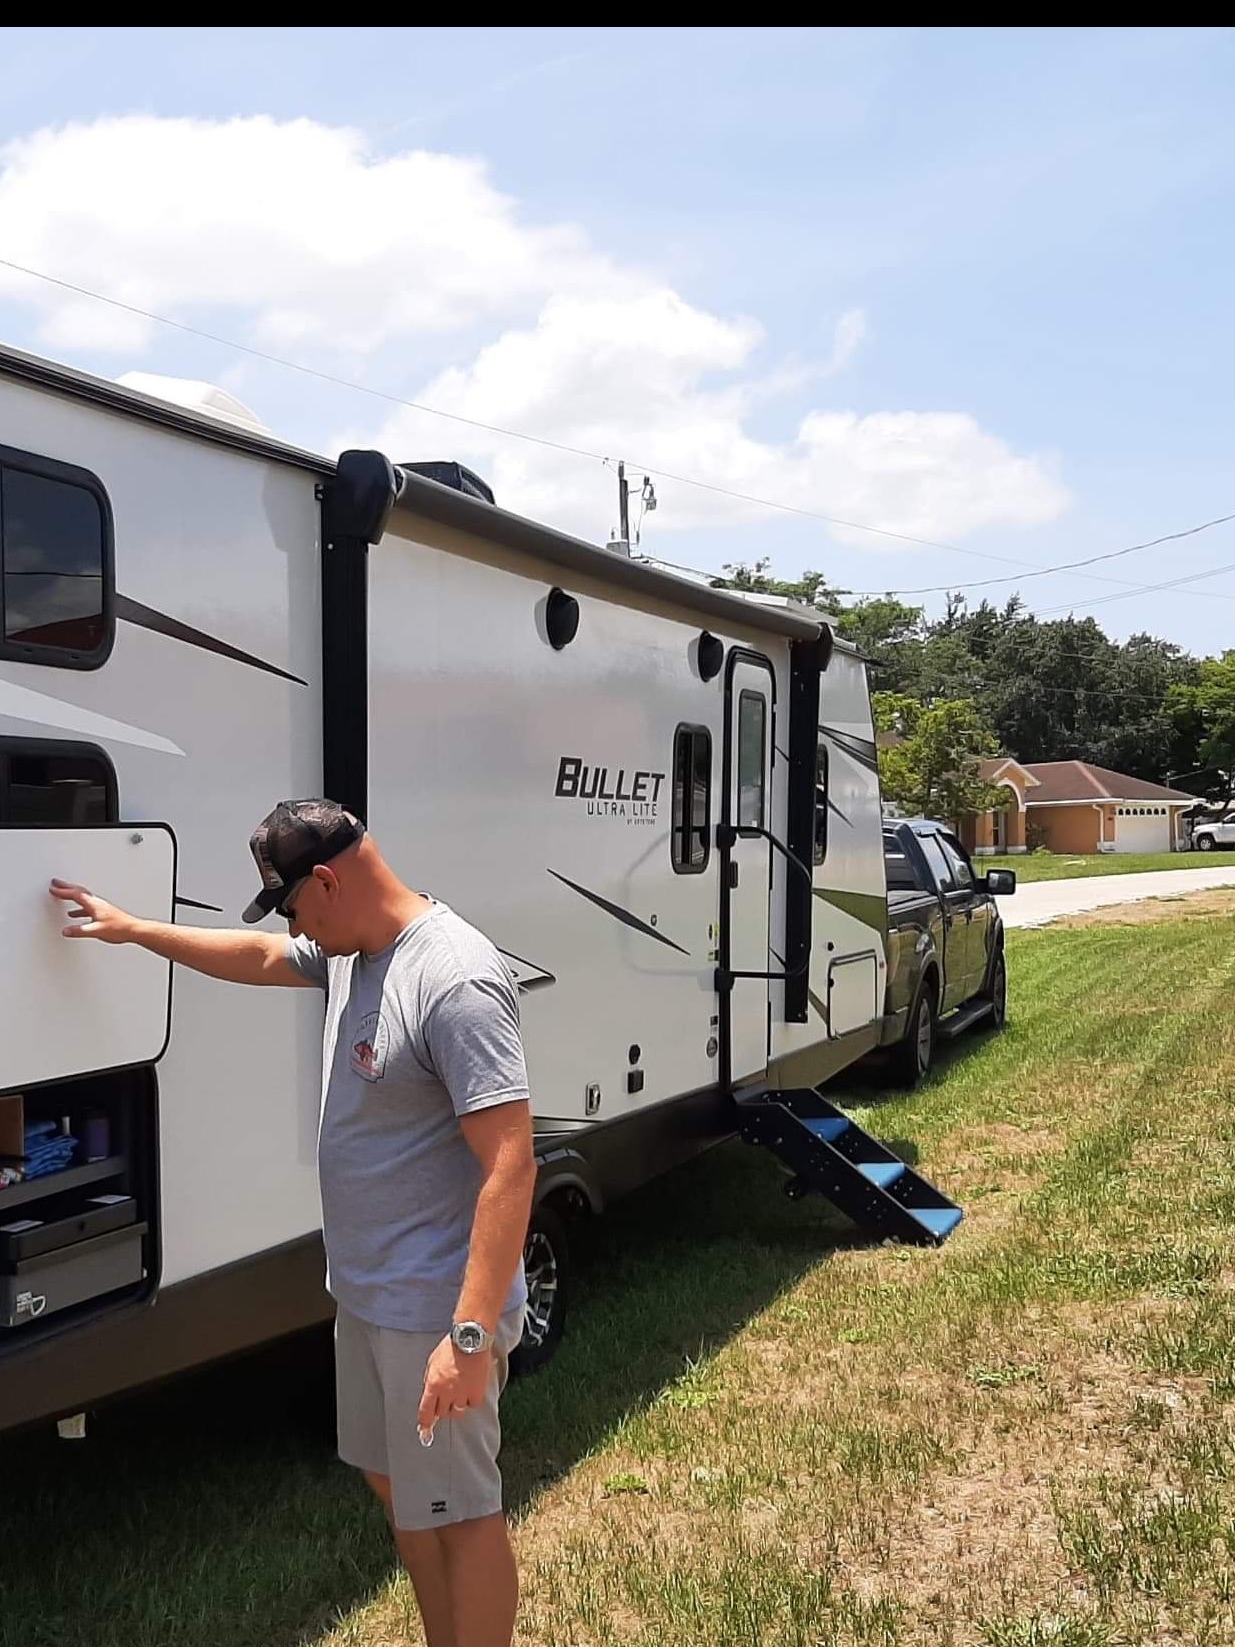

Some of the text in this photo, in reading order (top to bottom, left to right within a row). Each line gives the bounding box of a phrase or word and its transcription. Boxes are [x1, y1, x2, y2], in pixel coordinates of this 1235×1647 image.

[555, 756, 666, 802] BULLET
[587, 802, 658, 816] ULTRA LITE
